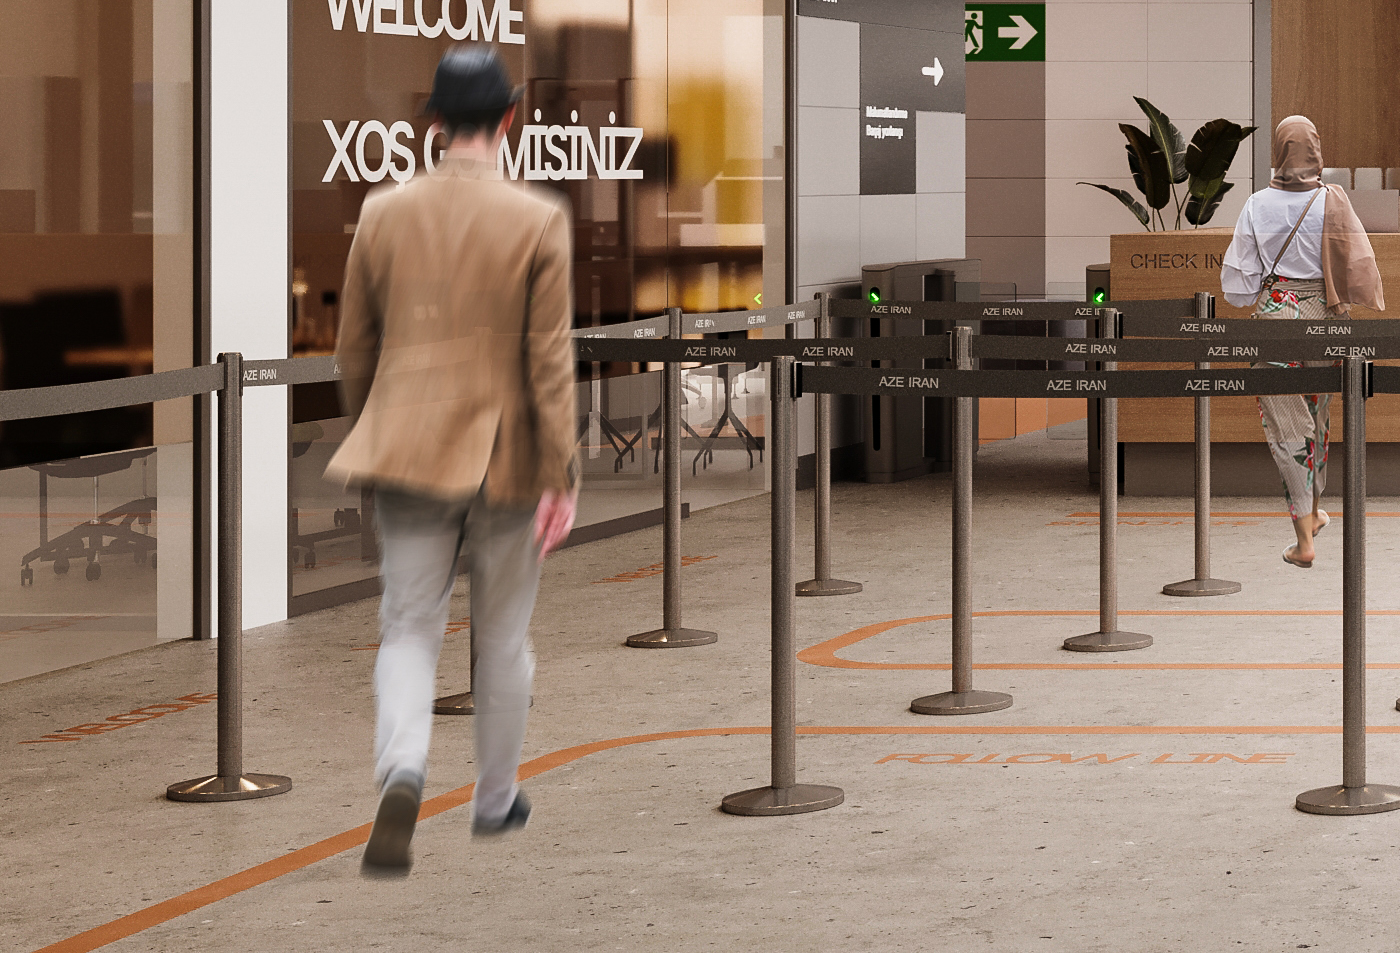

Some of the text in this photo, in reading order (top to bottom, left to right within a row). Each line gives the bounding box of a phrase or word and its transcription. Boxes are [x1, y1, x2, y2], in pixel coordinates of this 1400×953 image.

[321, 108, 645, 194] XOŞ GMİSİNİZ
[1130, 253, 1223, 270] CHECK IN
[871, 305, 911, 314] AZE IRAN
[983, 308, 1023, 316] AZE IRAN
[1075, 308, 1092, 316] AZE
[748, 315, 766, 324] AZE IRAN
[788, 311, 805, 320] AZE IRAN
[695, 319, 704, 328] AZE
[634, 328, 655, 338] AZE IRAN
[1180, 324, 1225, 333] AZE IRAN
[1306, 326, 1351, 334] AZE IRAN
[685, 347, 736, 356] AZE IRAN
[803, 347, 854, 356] AZE IRAN
[1065, 344, 1116, 354] AZE IRAN
[1208, 347, 1258, 356] AZE IRAN
[1325, 347, 1375, 356] AZE IRAN
[243, 368, 276, 381] AZE IRAN
[879, 377, 939, 388] AZE IRAN
[1047, 380, 1106, 390] AZE IRAN
[1185, 380, 1245, 390] AZE IRAN
[873, 752, 1296, 764] FOLLOW LINE
